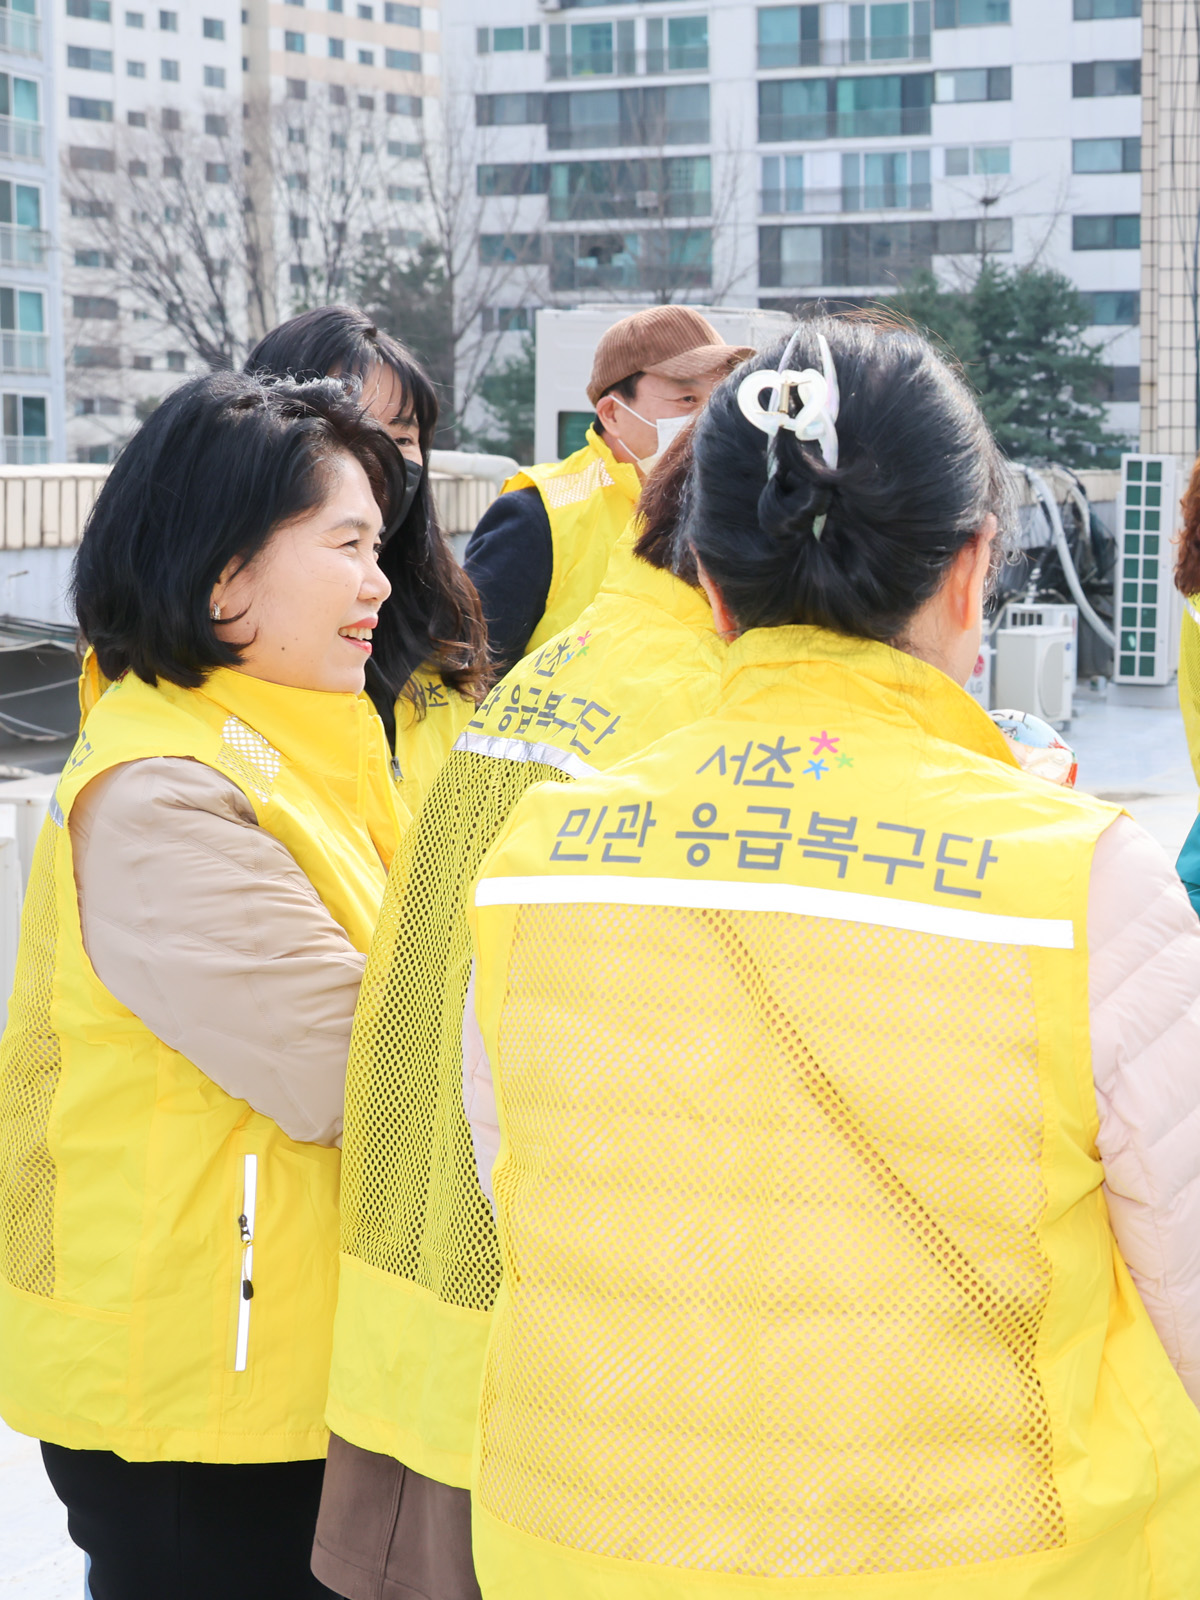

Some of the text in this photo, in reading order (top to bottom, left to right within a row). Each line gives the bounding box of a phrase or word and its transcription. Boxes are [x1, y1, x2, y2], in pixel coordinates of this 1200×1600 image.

[969, 681, 984, 694] LG
[498, 684, 621, 756] 응급복구단
[696, 735, 801, 789] 서초
[549, 801, 998, 899] 민관 응급복구단
